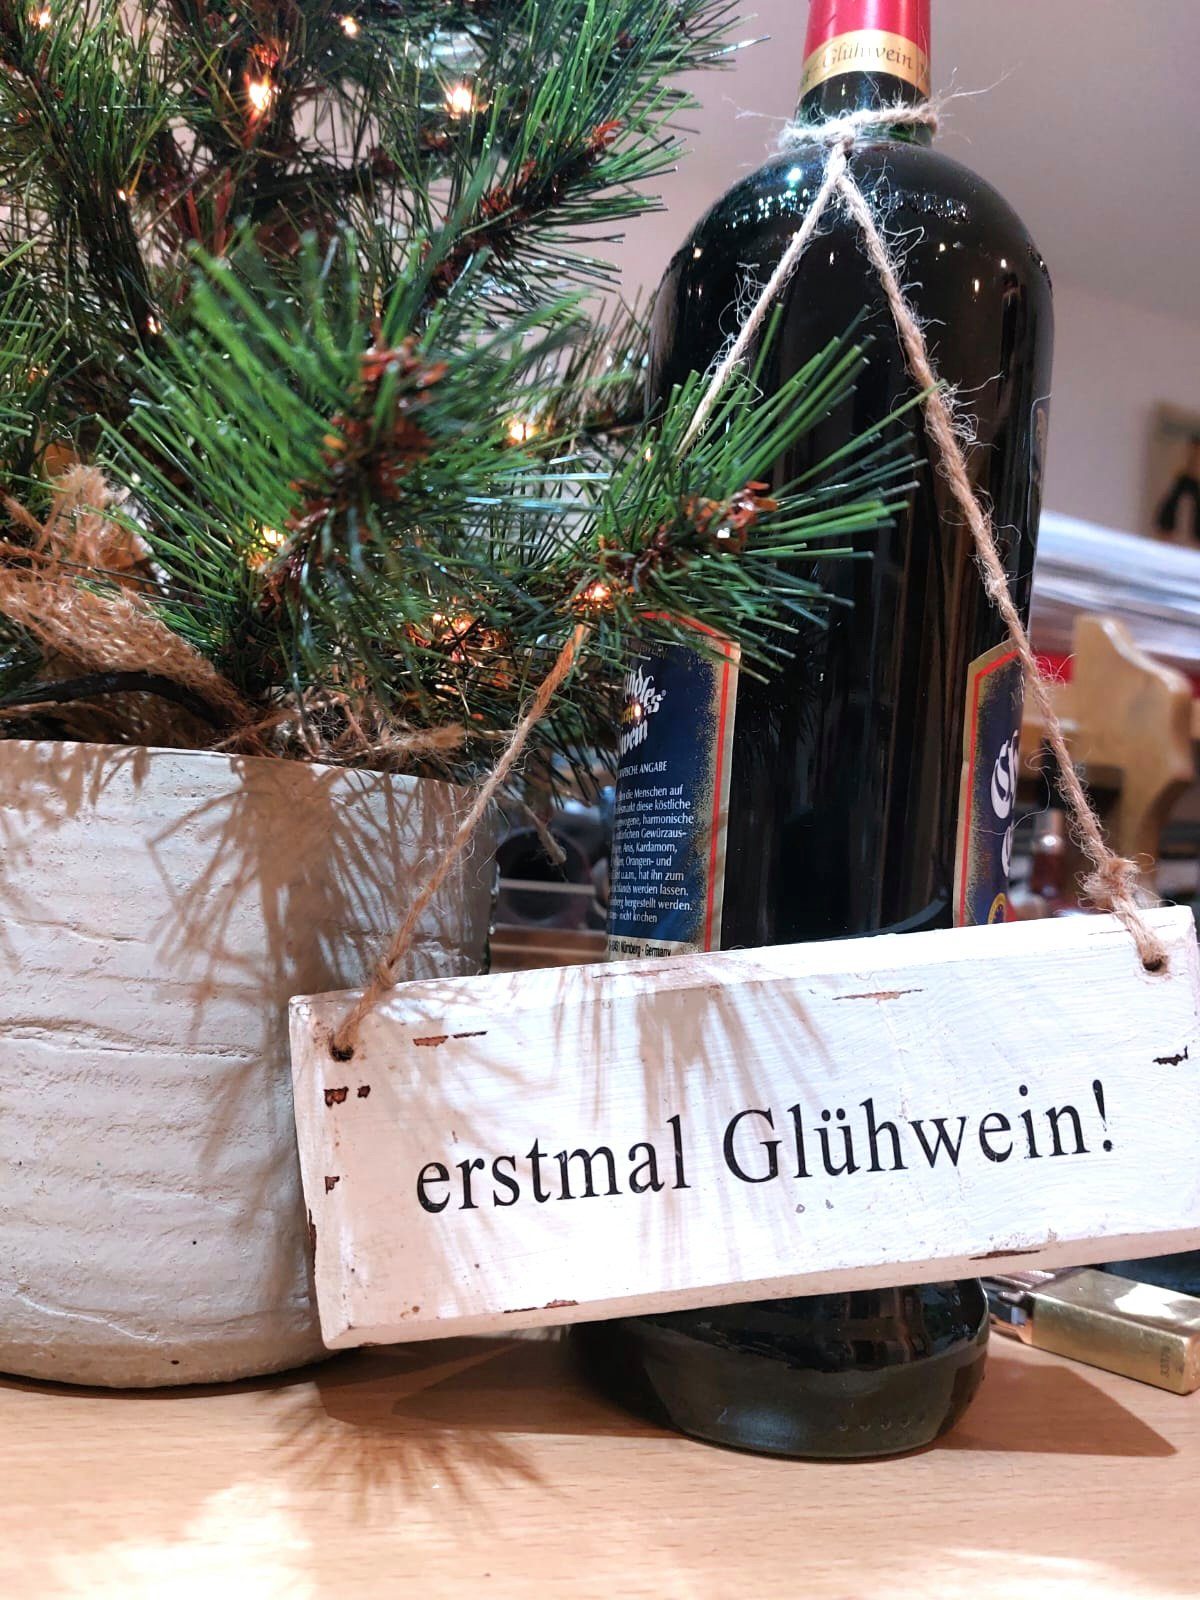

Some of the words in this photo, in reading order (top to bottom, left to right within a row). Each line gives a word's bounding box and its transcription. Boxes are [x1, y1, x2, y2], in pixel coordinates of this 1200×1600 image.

[822, 42, 913, 70] Glühwein
[640, 761, 668, 774] ANGABE
[634, 786, 668, 798] Menschen
[669, 783, 684, 796] auf
[636, 800, 653, 811] diese
[654, 799, 692, 810] köstliche
[642, 812, 694, 825] harmonische
[641, 827, 687, 839] Gewürzaus-
[636, 841, 678, 854] Kardamom,
[625, 856, 655, 868] Orangen-
[656, 856, 672, 867] und
[639, 867, 649, 880] hat
[651, 869, 663, 880] ihn
[665, 872, 684, 881] zum
[632, 882, 658, 895] werden
[660, 883, 689, 896] lassen.
[624, 896, 656, 910] hergestellt
[658, 899, 693, 911] werden.
[632, 911, 658, 923] kochen
[644, 944, 672, 958] Germany
[416, 1114, 692, 1214] erstmal
[722, 1079, 1114, 1184] Glühwein!
